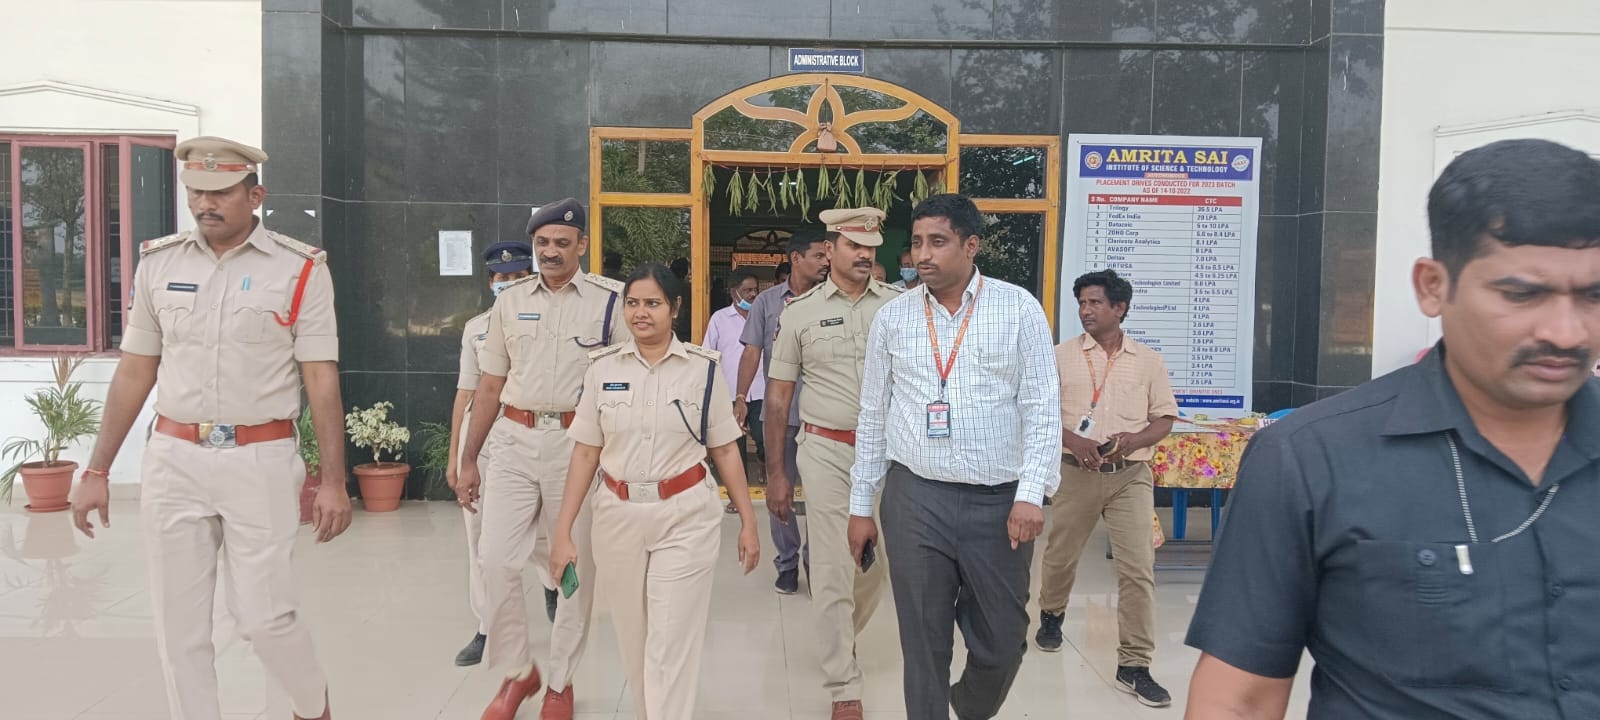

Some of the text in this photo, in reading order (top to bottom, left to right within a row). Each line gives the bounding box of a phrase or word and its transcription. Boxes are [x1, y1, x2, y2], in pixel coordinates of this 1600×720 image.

[794, 54, 859, 66] ADMINISTRATIVE BLOCK
[1106, 148, 1228, 164] AMRITA SAI
